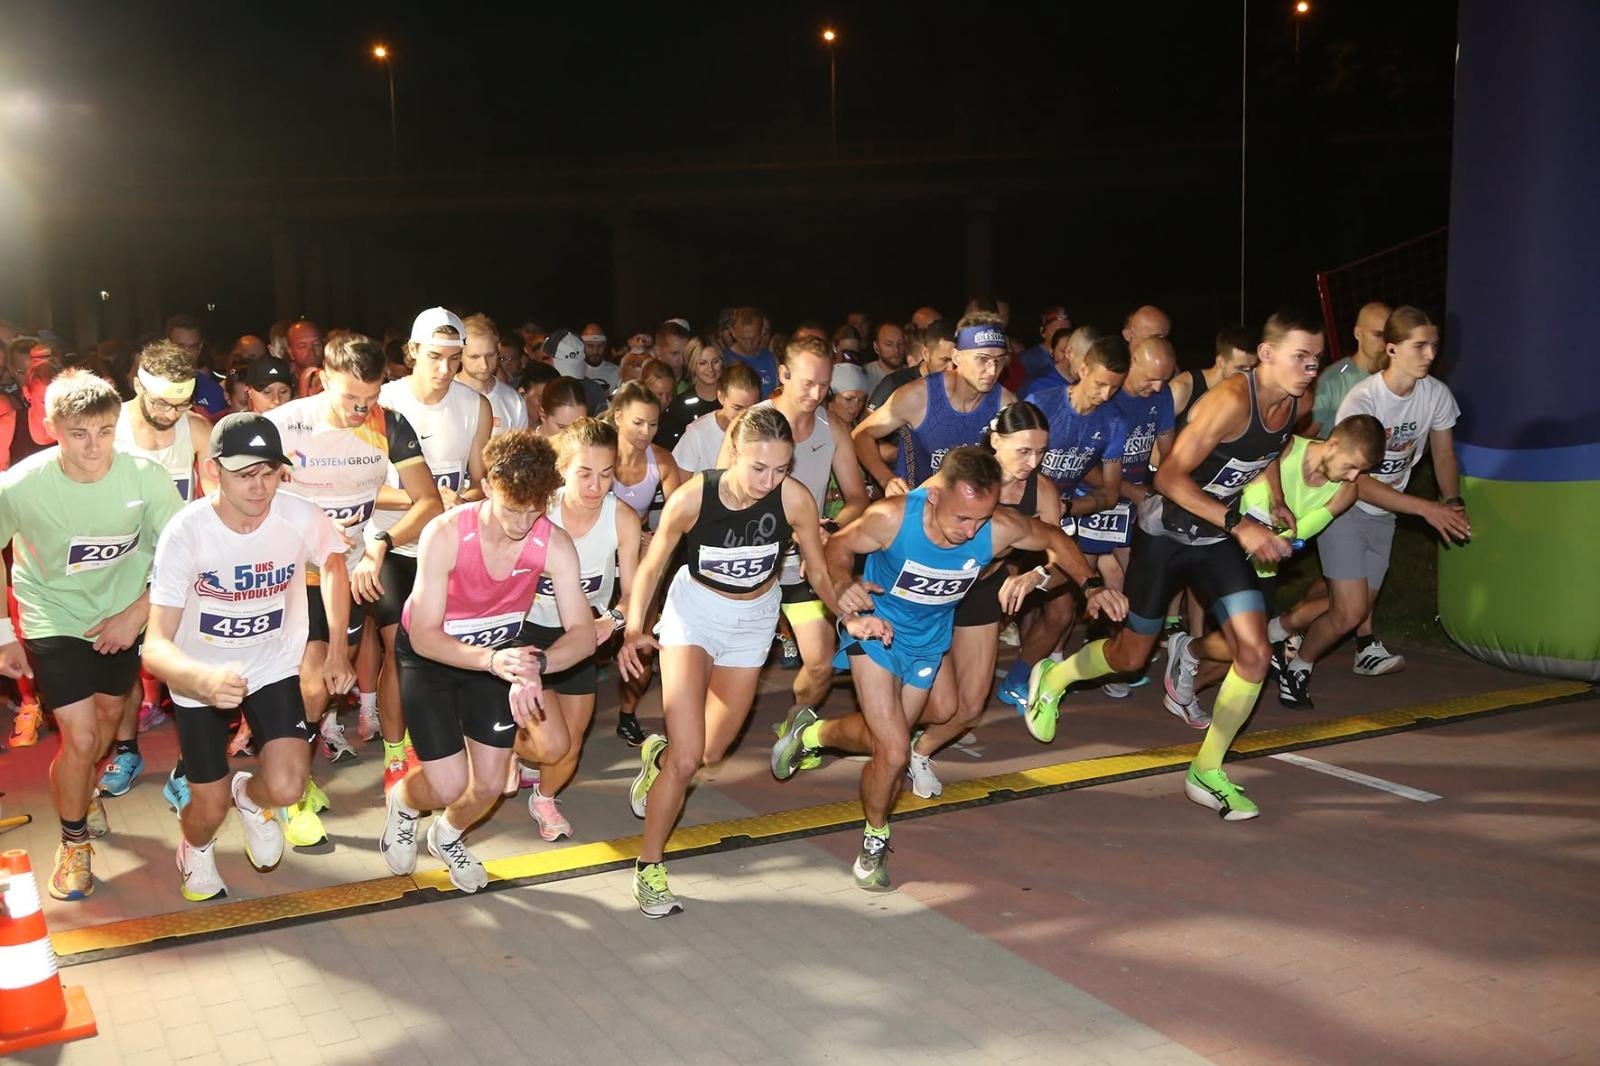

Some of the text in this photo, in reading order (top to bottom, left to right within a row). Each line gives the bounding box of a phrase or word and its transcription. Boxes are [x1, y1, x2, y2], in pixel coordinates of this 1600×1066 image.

[309, 454, 382, 467] SYSTEM GROUP
[1088, 513, 1119, 531] 311
[81, 539, 136, 560] 207
[255, 561, 274, 573] UKS
[713, 558, 764, 578] 455
[234, 563, 296, 592] 5 PLUS
[542, 579, 591, 595] 32
[908, 577, 962, 595] 243
[234, 581, 290, 601] RYDUŁTOW
[213, 615, 270, 636] 458
